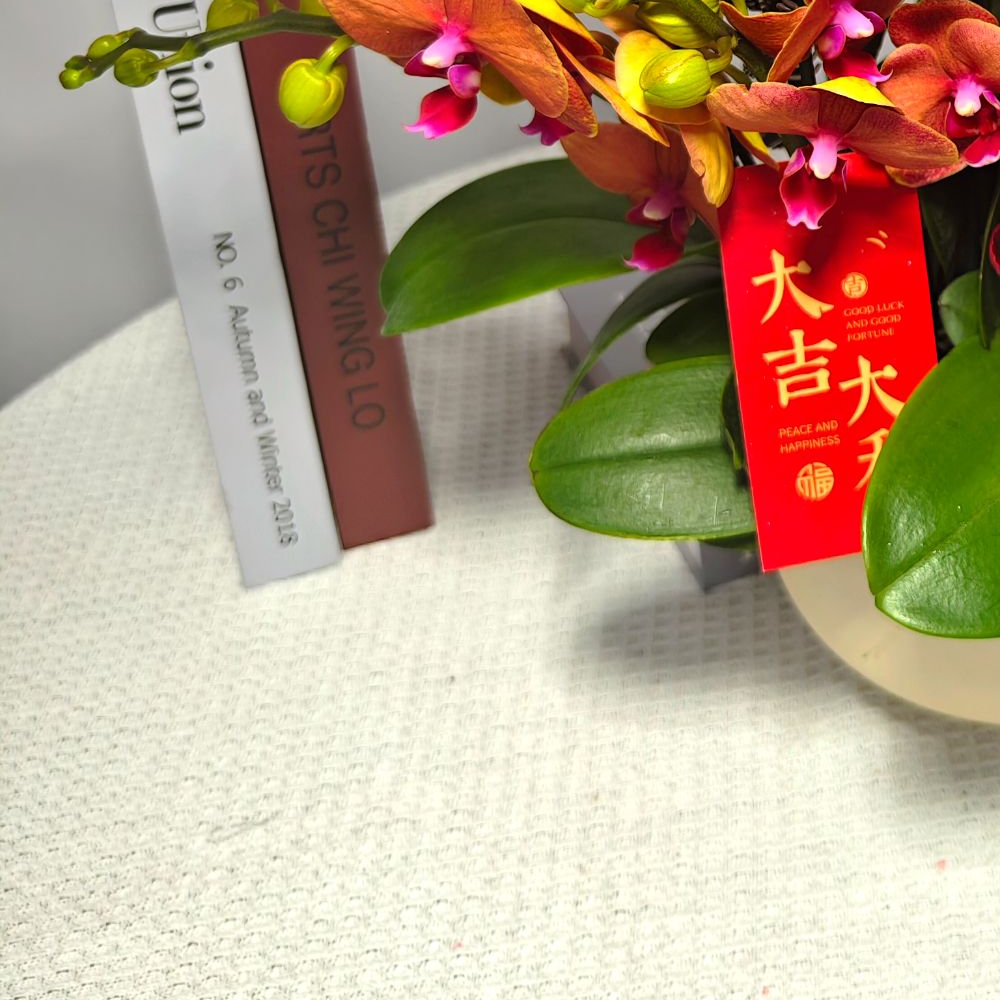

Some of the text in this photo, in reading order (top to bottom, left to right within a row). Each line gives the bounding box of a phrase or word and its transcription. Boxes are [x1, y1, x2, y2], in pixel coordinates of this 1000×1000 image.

[213, 231, 237, 269] NO.
[312, 199, 356, 267] CHI
[223, 276, 244, 291] 6
[327, 273, 376, 376] WING
[843, 300, 905, 317] GOOD LUCK
[846, 314, 902, 330] AND GOOD
[229, 305, 260, 385] Autumn
[752, 249, 837, 408] 大吉
[847, 327, 895, 342] FORTUNE
[248, 389, 273, 427] and
[347, 382, 387, 430] LO
[779, 420, 839, 438] PEACE AND
[780, 435, 841, 454] HAPPINESS
[257, 429, 284, 494] Winter
[795, 462, 835, 502] 福
